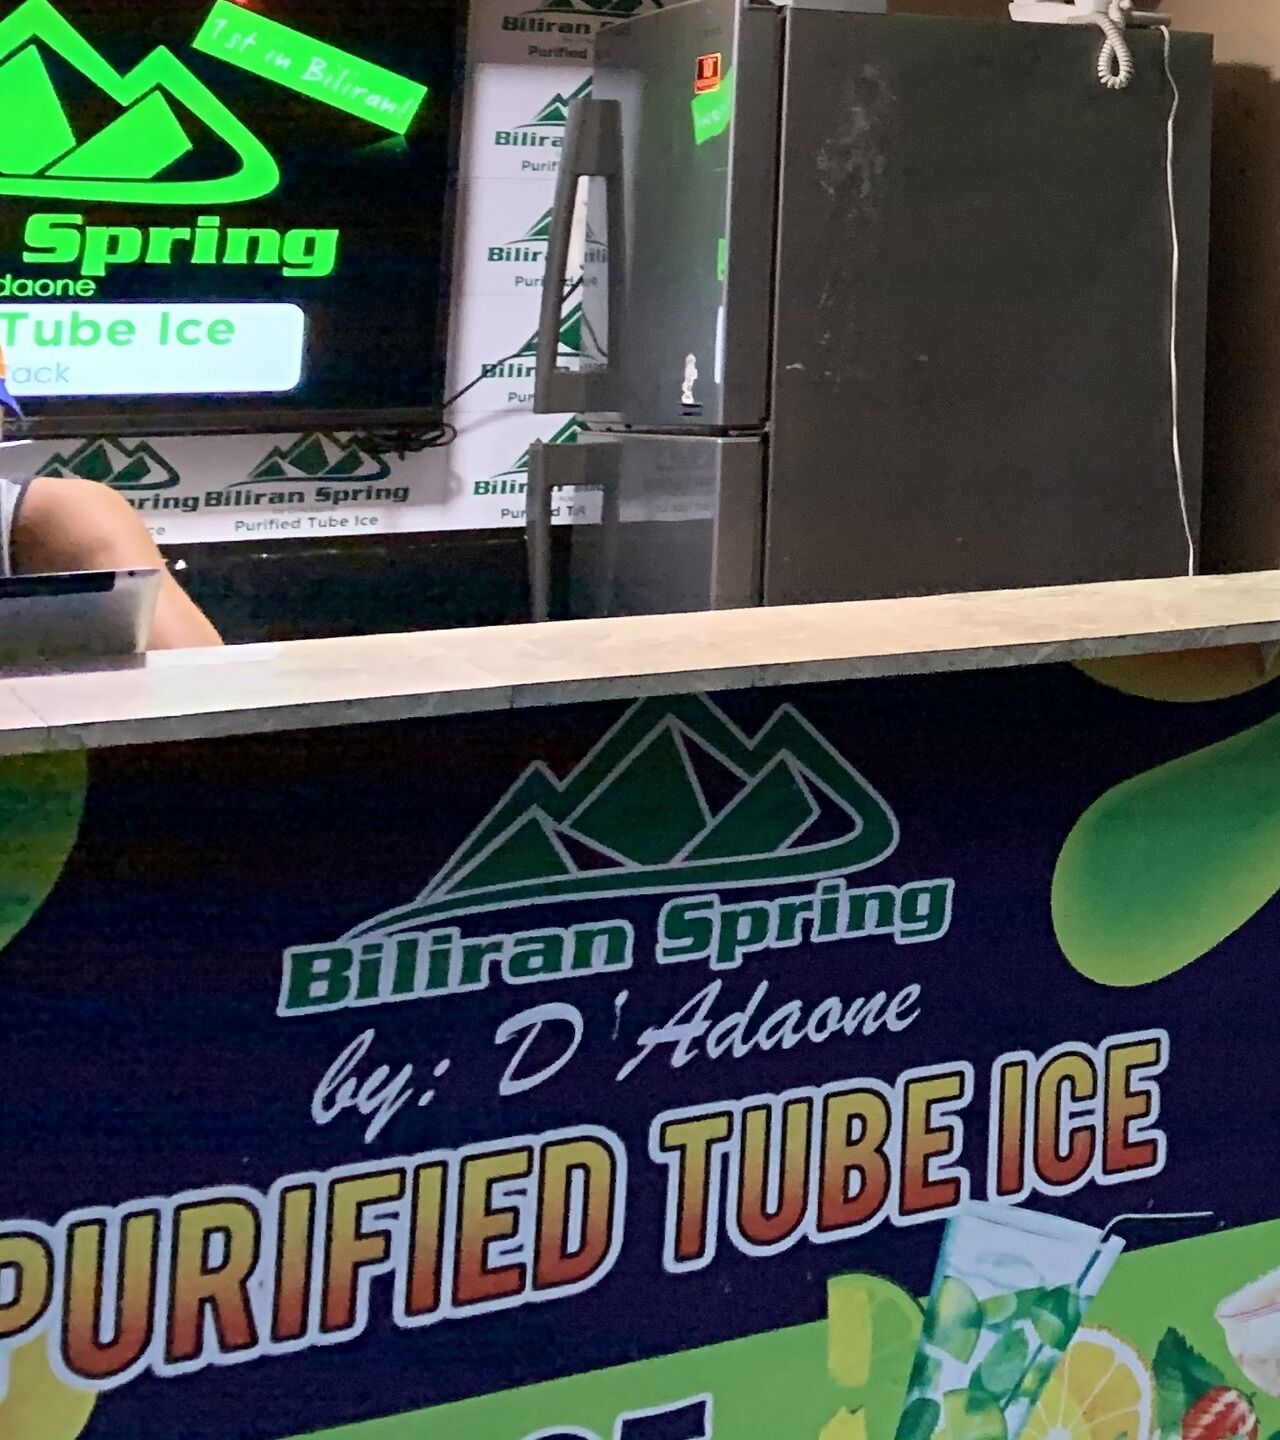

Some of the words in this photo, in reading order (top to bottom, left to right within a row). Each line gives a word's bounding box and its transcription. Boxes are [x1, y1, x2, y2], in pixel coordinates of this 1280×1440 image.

[501, 15, 591, 35] Biliran
[264, 48, 293, 70] in
[527, 45, 588, 60] Purified
[494, 131, 563, 148] Bilira
[23, 213, 340, 277] Spring
[0, 310, 136, 348] Tube
[159, 311, 236, 346] Ice
[204, 489, 305, 508] Biliran
[314, 484, 410, 504] Spring
[234, 519, 302, 534] Purified
[307, 516, 349, 530] Tube
[354, 514, 379, 528] Ice
[278, 917, 635, 1018] Biliran
[656, 876, 955, 970] Spring
[311, 1028, 451, 1143] by:
[658, 1068, 970, 1266] TUBE
[995, 1034, 1165, 1203] ICE
